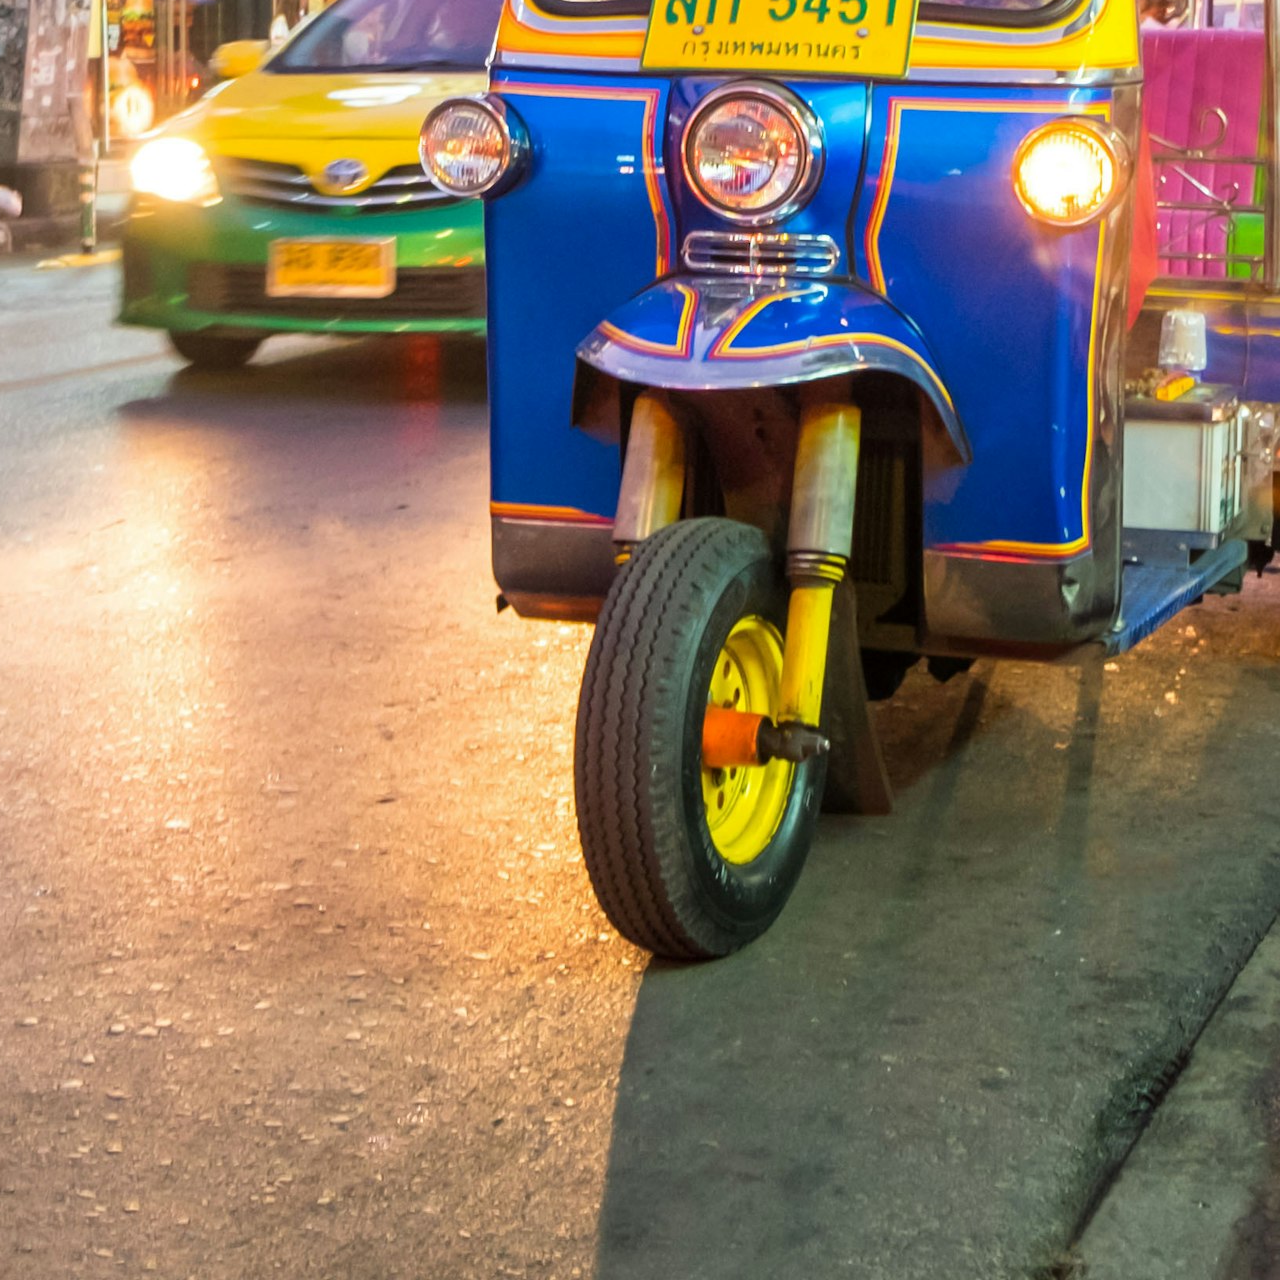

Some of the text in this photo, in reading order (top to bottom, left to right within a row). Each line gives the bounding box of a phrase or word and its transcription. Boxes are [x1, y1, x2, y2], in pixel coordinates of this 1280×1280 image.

[681, 39, 862, 63] กรุงเทพมหานคร
